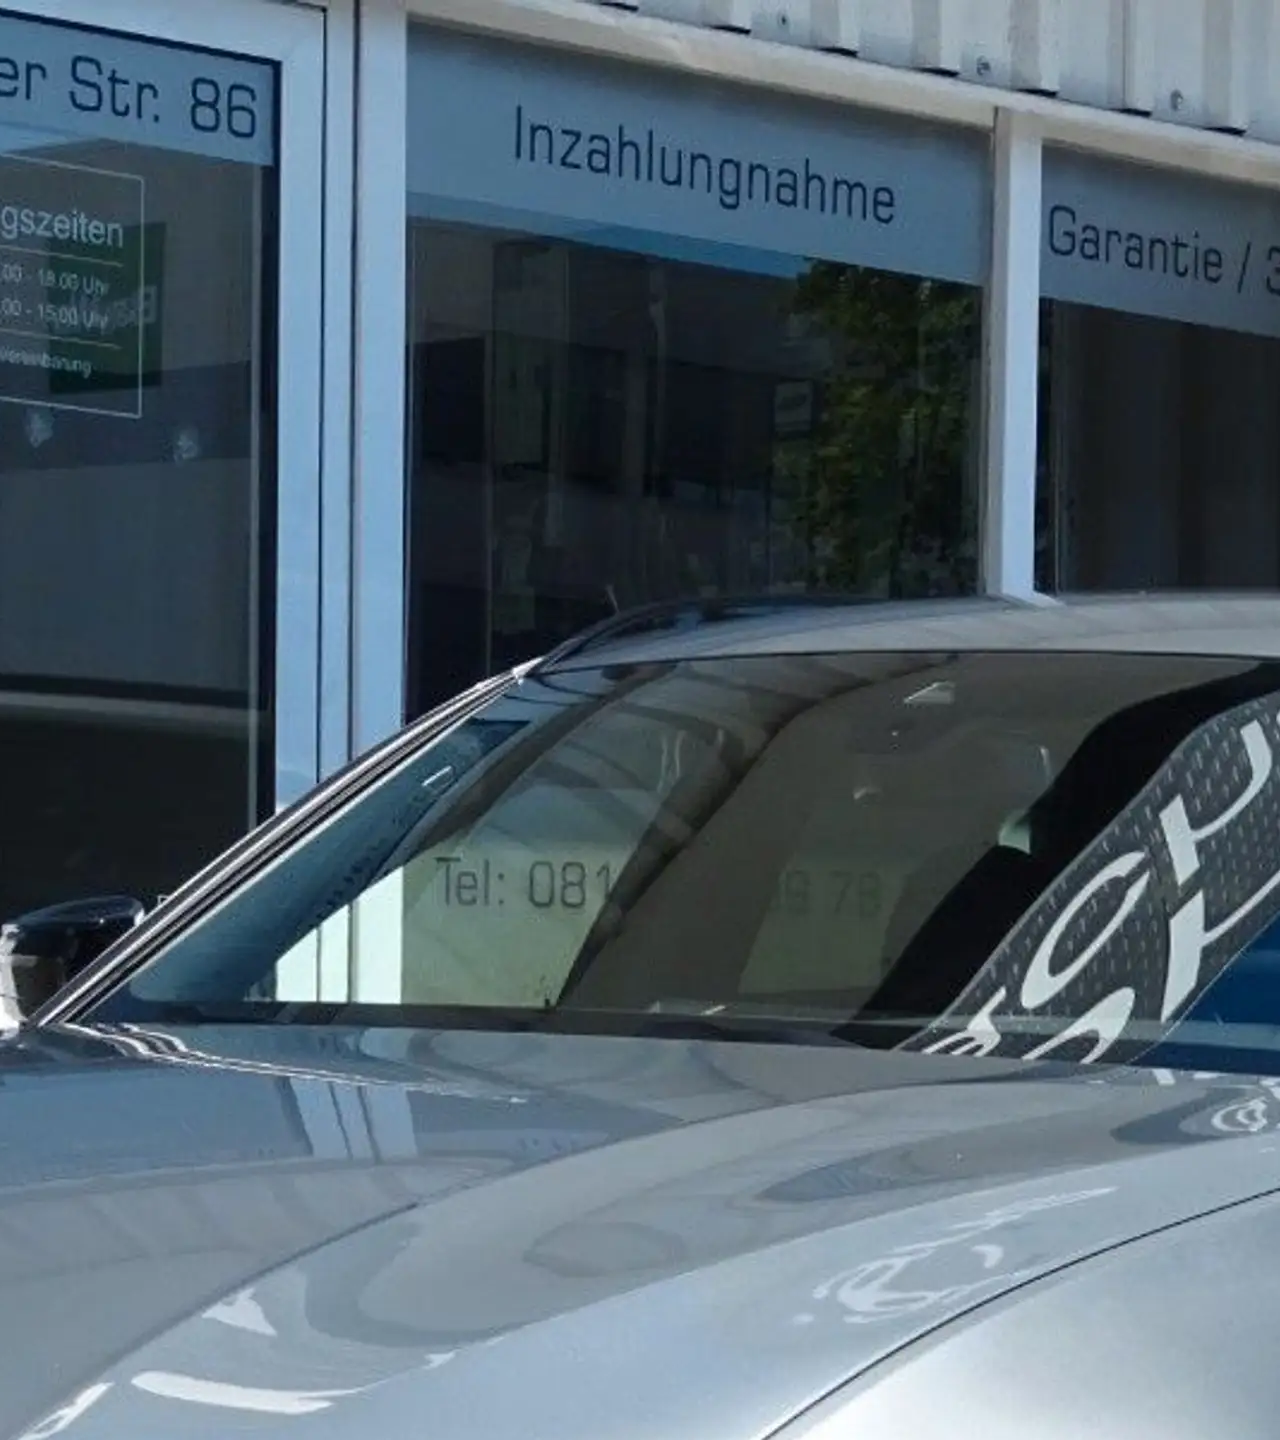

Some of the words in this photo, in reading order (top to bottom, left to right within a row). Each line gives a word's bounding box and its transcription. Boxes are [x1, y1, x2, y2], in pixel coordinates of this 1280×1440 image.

[70, 54, 161, 124] Str.
[189, 76, 257, 140] 86
[513, 103, 896, 226] Inzahlungnahme
[1047, 205, 1224, 285] Garantie
[1231, 242, 1254, 294] /
[433, 855, 505, 908] Tel:
